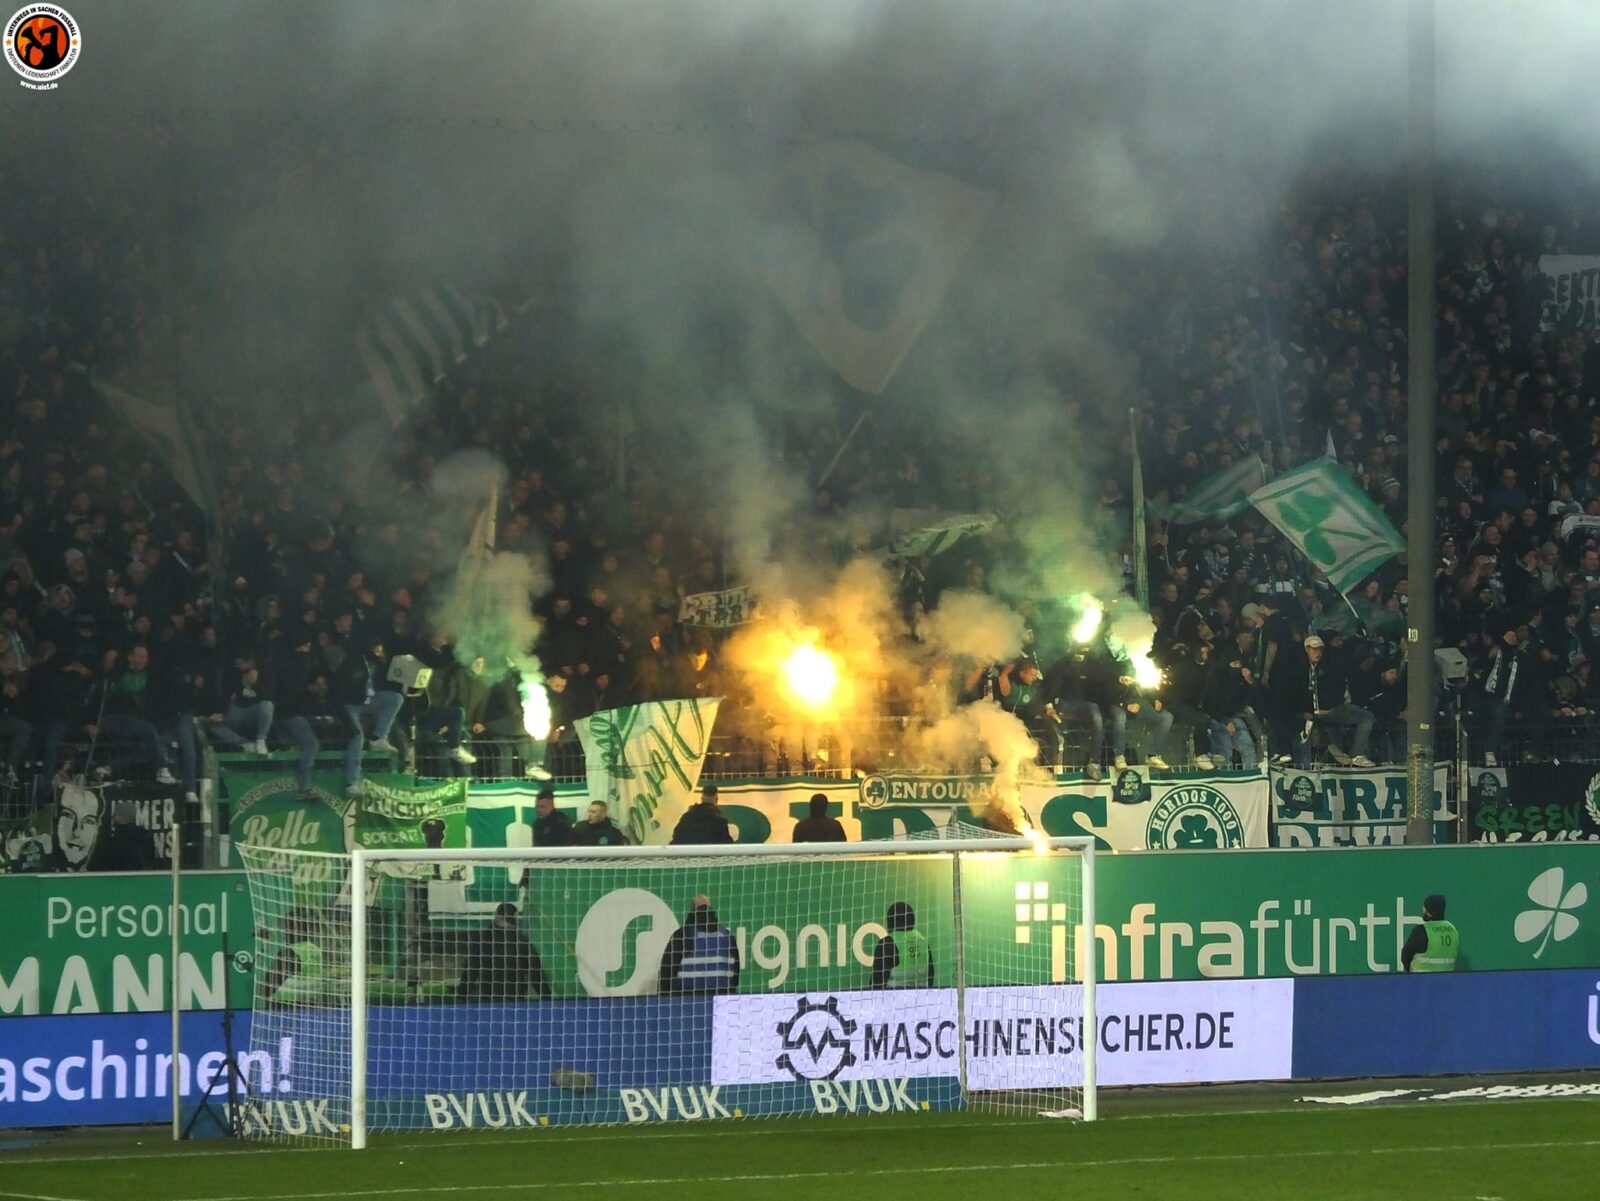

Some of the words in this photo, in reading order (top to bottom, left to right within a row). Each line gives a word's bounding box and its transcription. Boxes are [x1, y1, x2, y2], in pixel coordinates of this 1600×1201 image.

[1151, 789, 1208, 832] HORIDOS
[1212, 797, 1237, 831] 1000
[47, 892, 227, 939] Personal
[1051, 896, 1424, 982] infrafürth
[1440, 936, 1452, 947] 10
